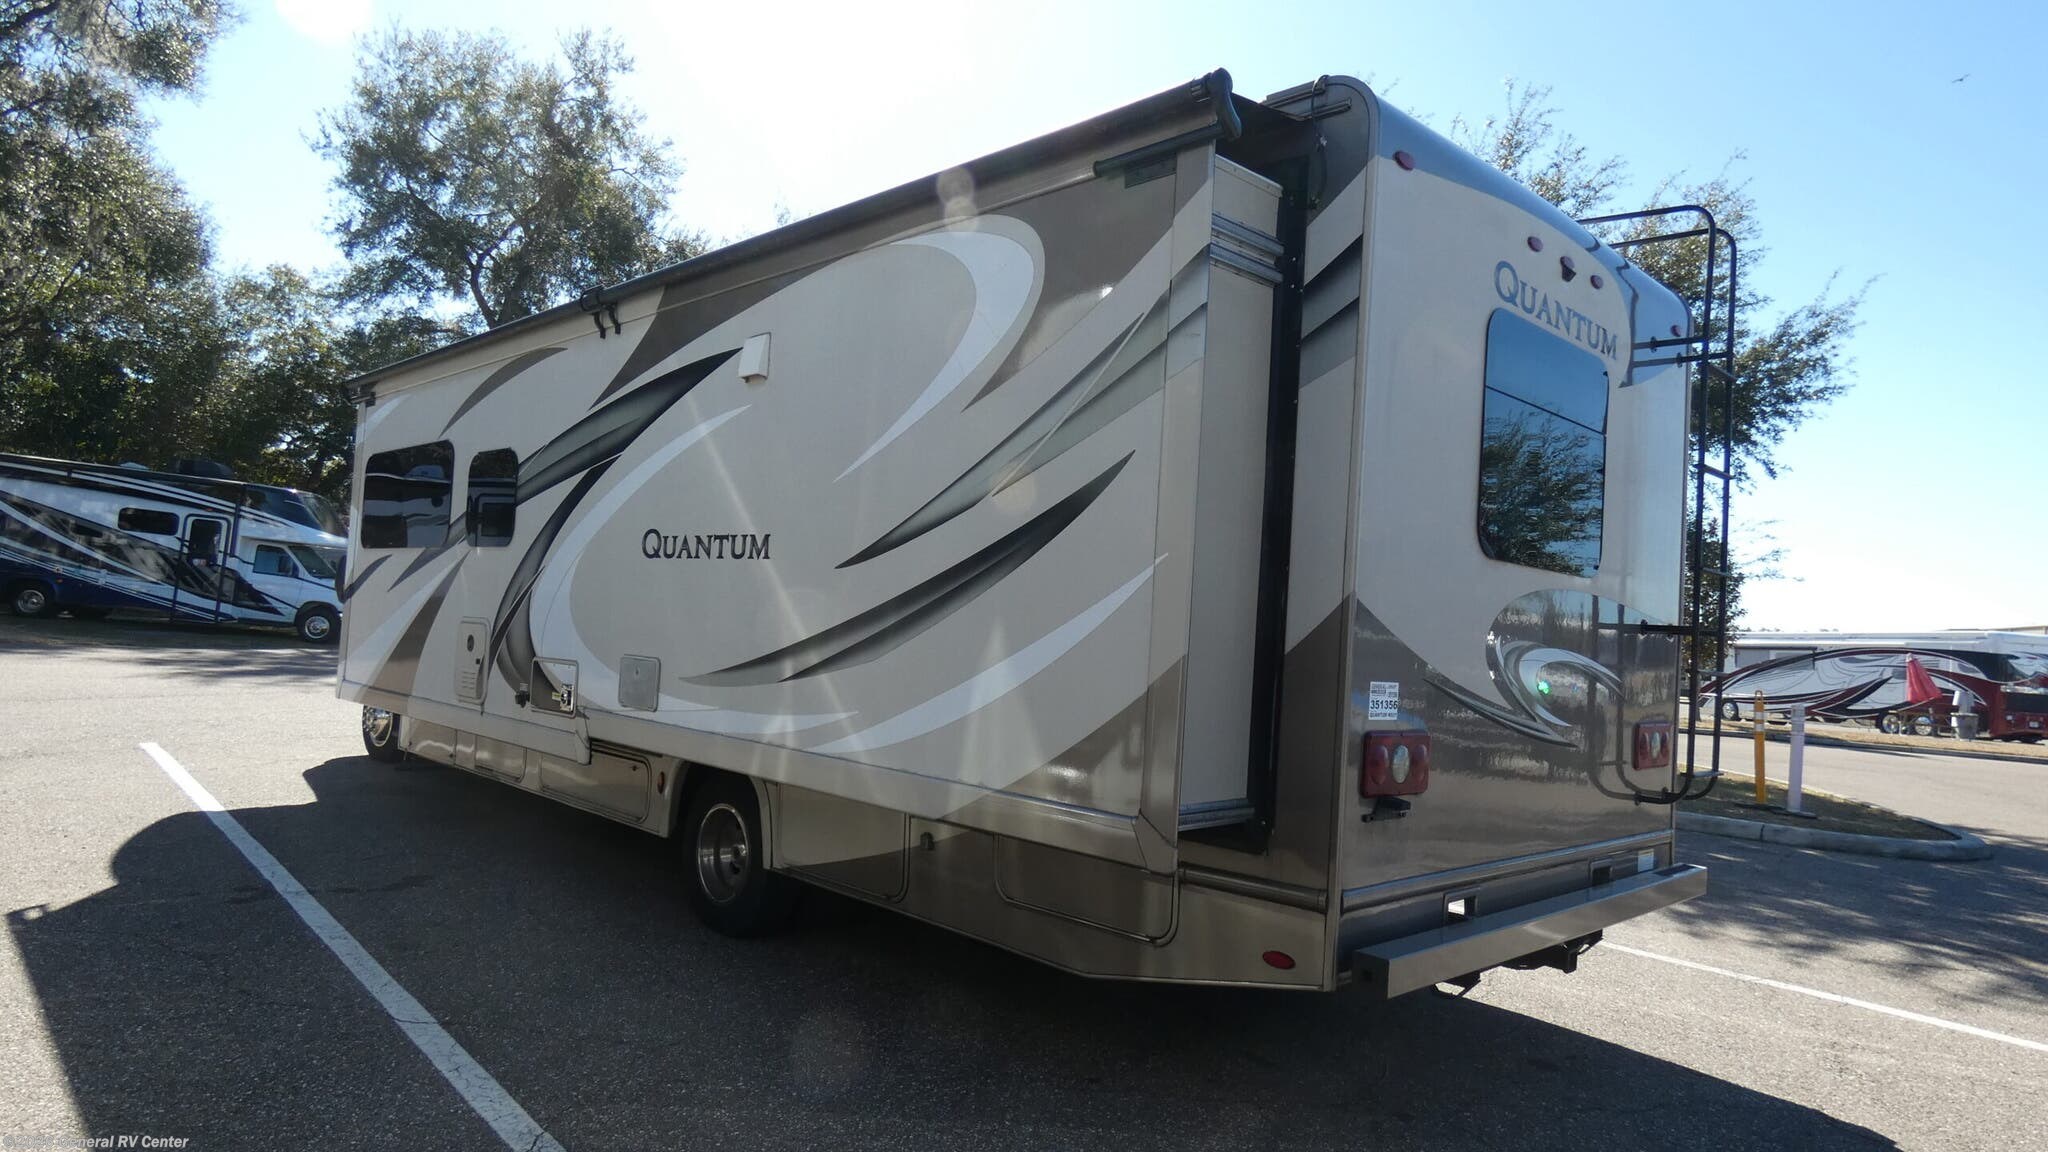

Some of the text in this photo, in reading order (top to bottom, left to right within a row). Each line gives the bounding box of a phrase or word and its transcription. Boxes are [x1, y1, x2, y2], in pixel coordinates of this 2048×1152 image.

[1494, 260, 1617, 360] QUANTUM
[641, 528, 771, 560] QUANTUM
[1370, 700, 1398, 709] 351356
